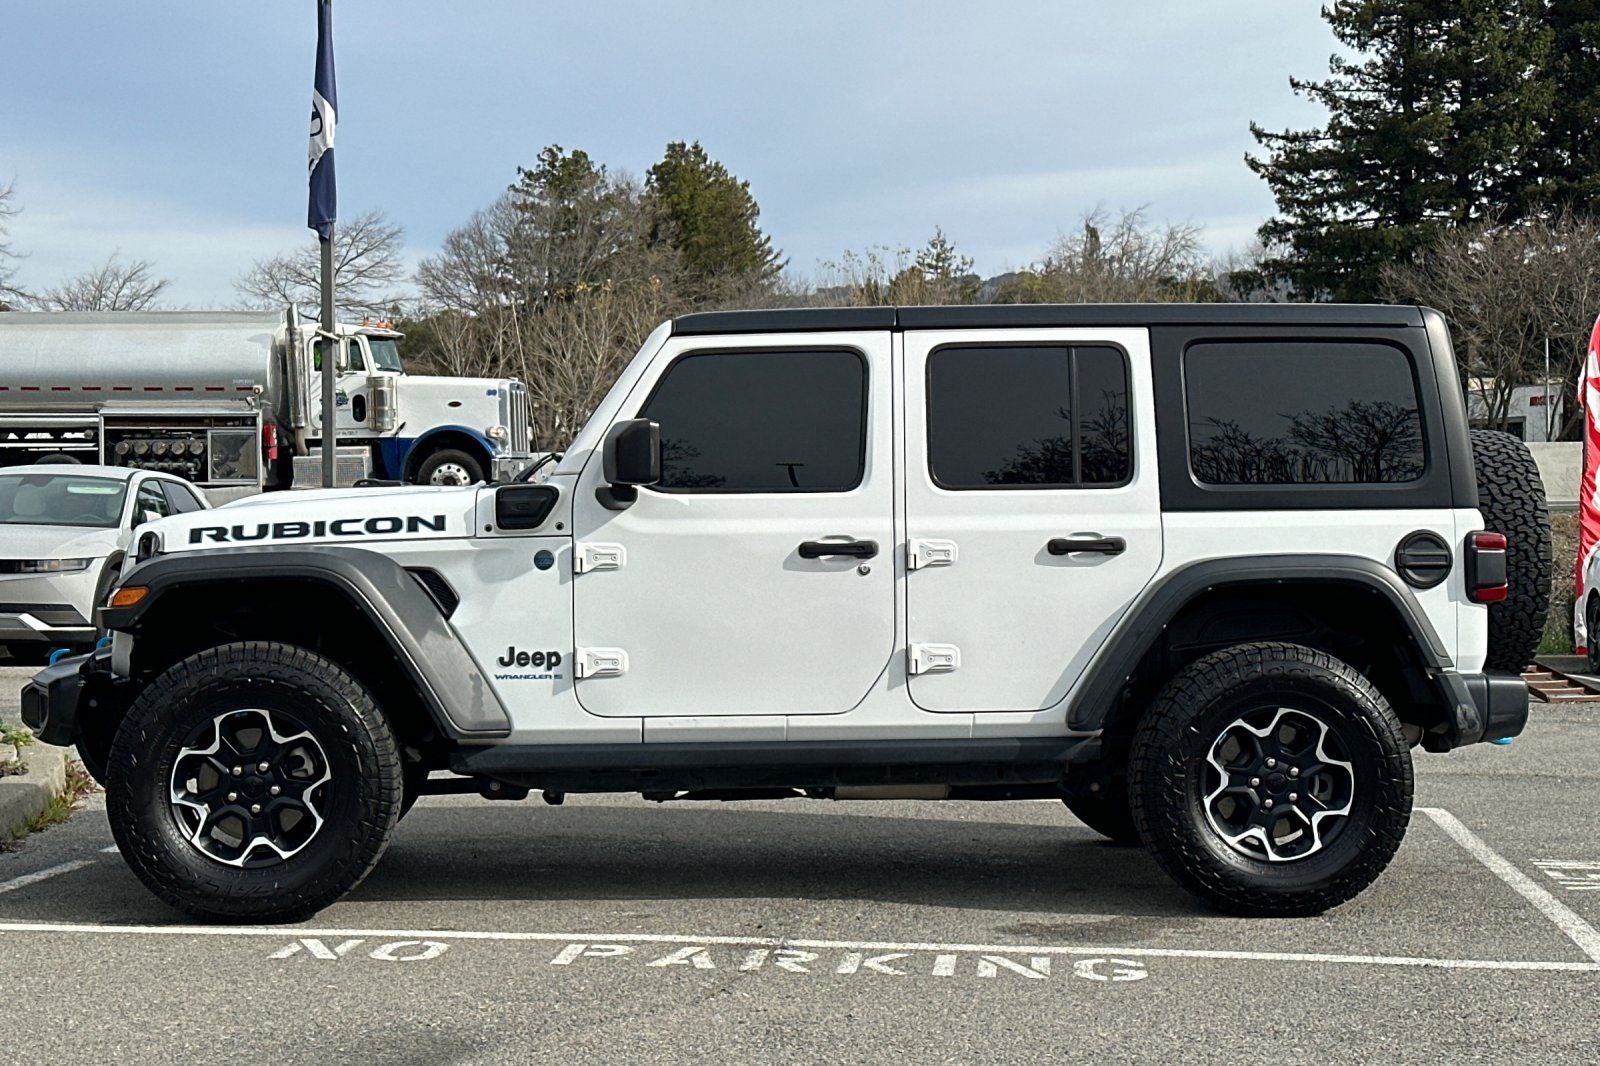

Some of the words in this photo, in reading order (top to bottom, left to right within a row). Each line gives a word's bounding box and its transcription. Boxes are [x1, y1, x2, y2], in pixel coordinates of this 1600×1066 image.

[189, 515, 446, 544] RUBICON
[498, 646, 562, 671] Jeep
[266, 938, 450, 961] NO
[550, 943, 1148, 981] PARKING
